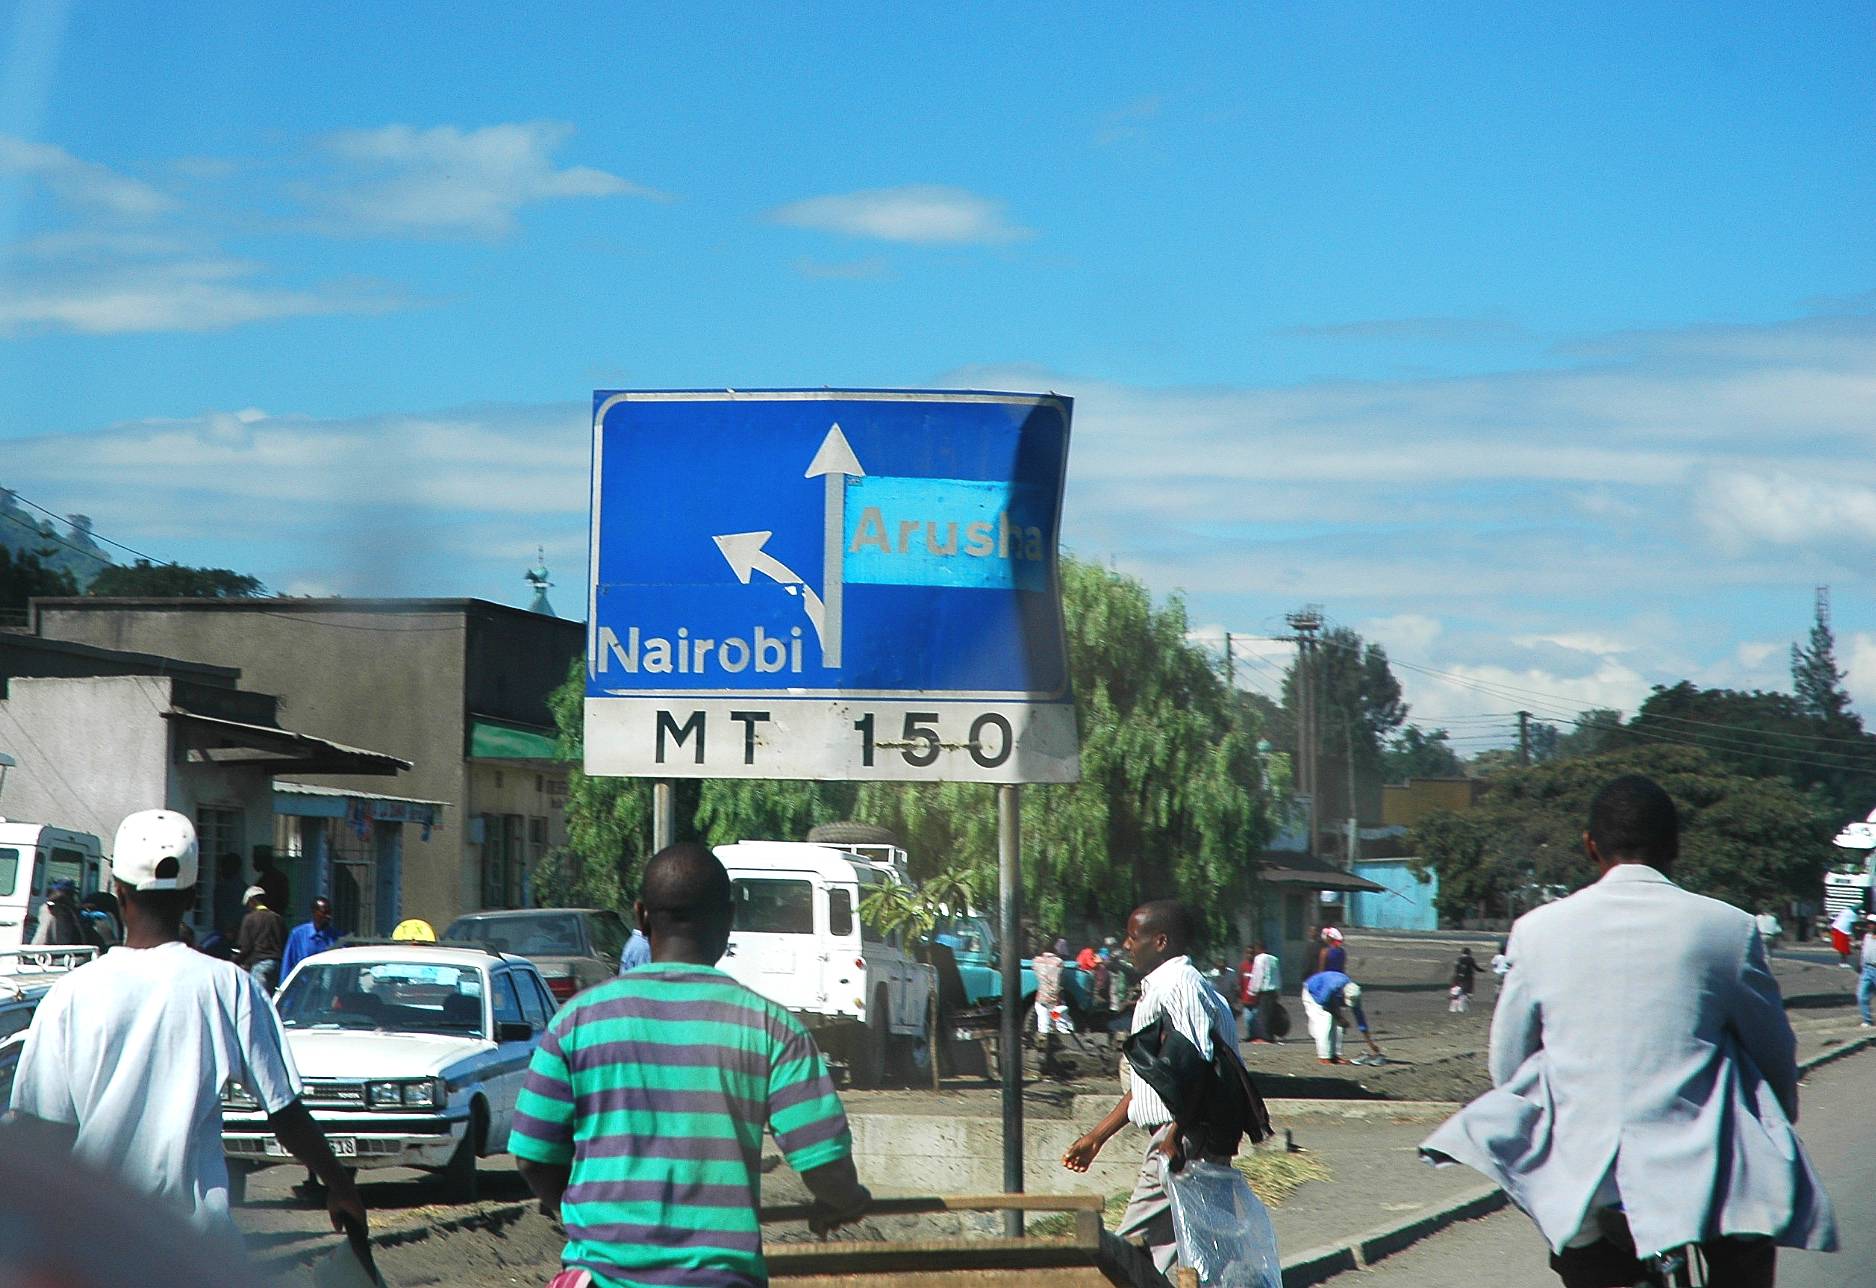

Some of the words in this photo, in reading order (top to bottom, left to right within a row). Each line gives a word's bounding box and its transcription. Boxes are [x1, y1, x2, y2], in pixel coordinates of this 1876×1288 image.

[849, 506, 1042, 561] Arusha
[598, 626, 803, 674] Nairobi
[853, 712, 1013, 768] 150
